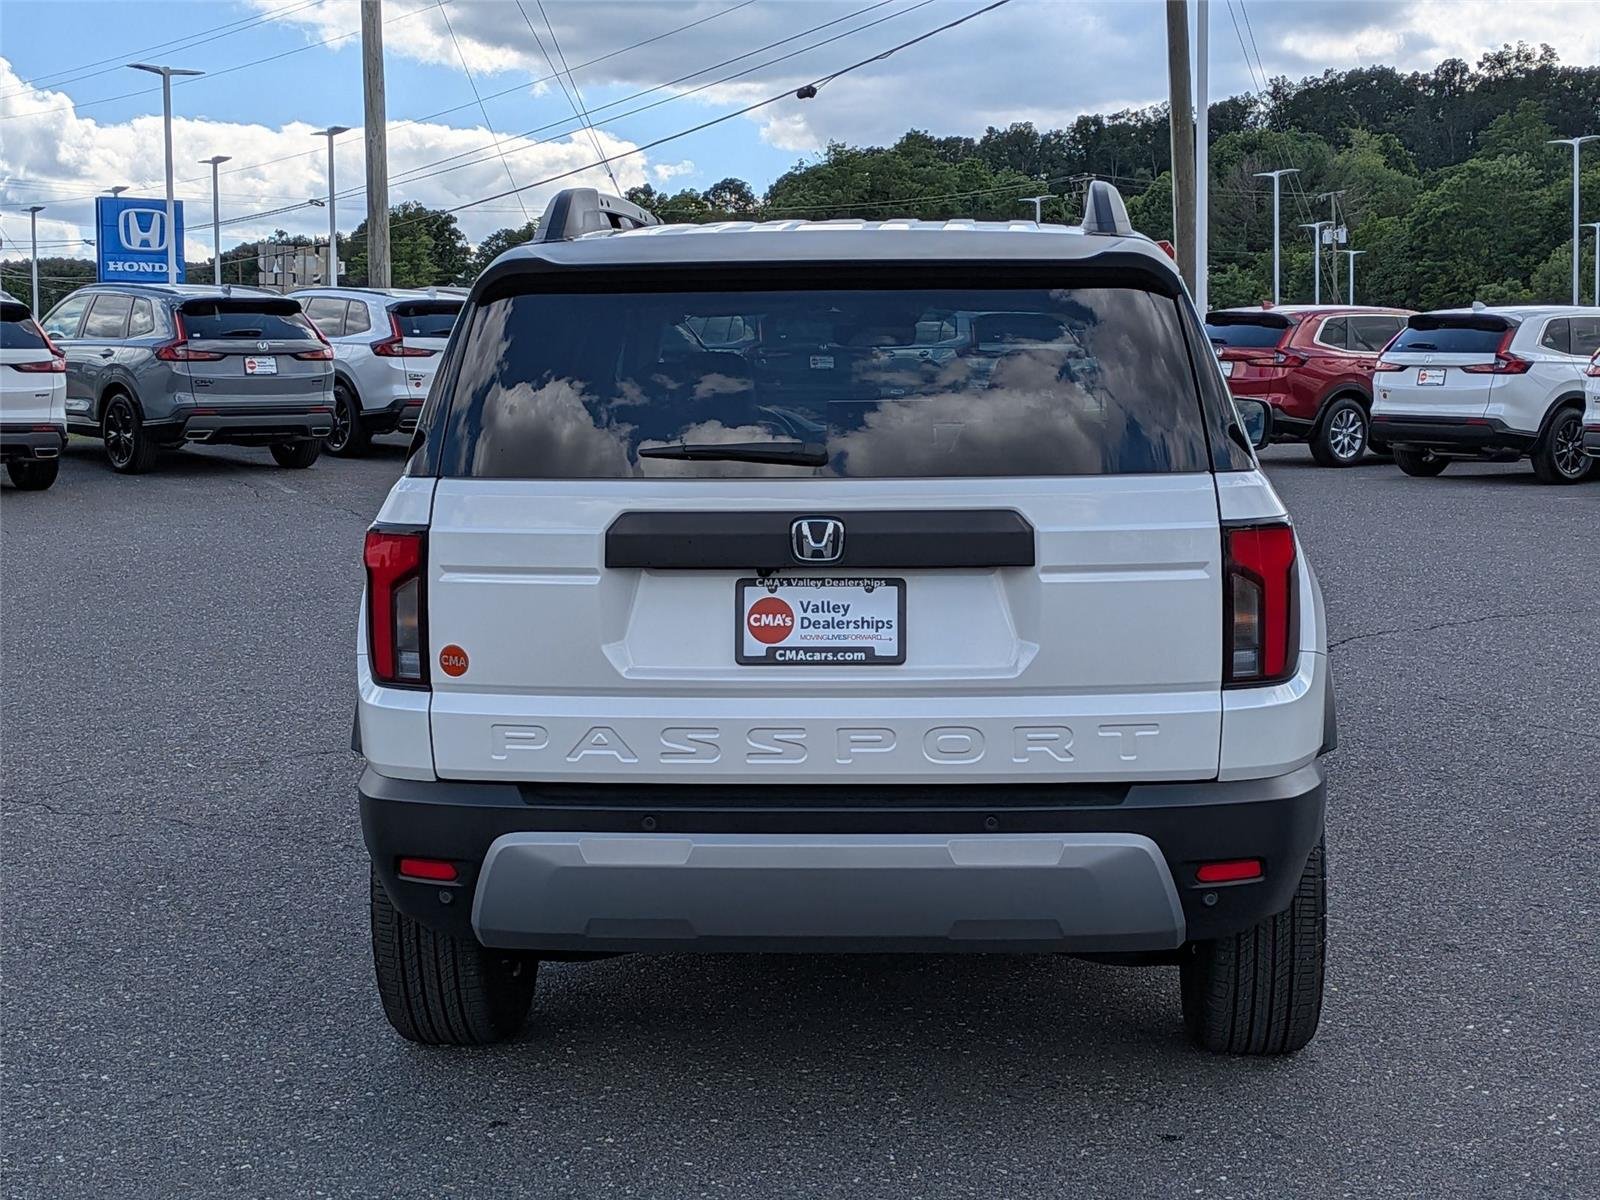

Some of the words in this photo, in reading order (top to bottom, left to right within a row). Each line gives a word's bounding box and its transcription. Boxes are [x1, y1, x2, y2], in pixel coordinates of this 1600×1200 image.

[756, 578, 788, 587] CMA's
[790, 578, 825, 589] Valley
[825, 578, 887, 589] Dealerships
[799, 600, 851, 616] Valley
[749, 614, 793, 627] CMA's
[800, 616, 893, 632] Dealerships
[440, 654, 467, 667] CMA
[775, 650, 866, 661] CMAcars.com
[490, 723, 1160, 765] PASSPORT
